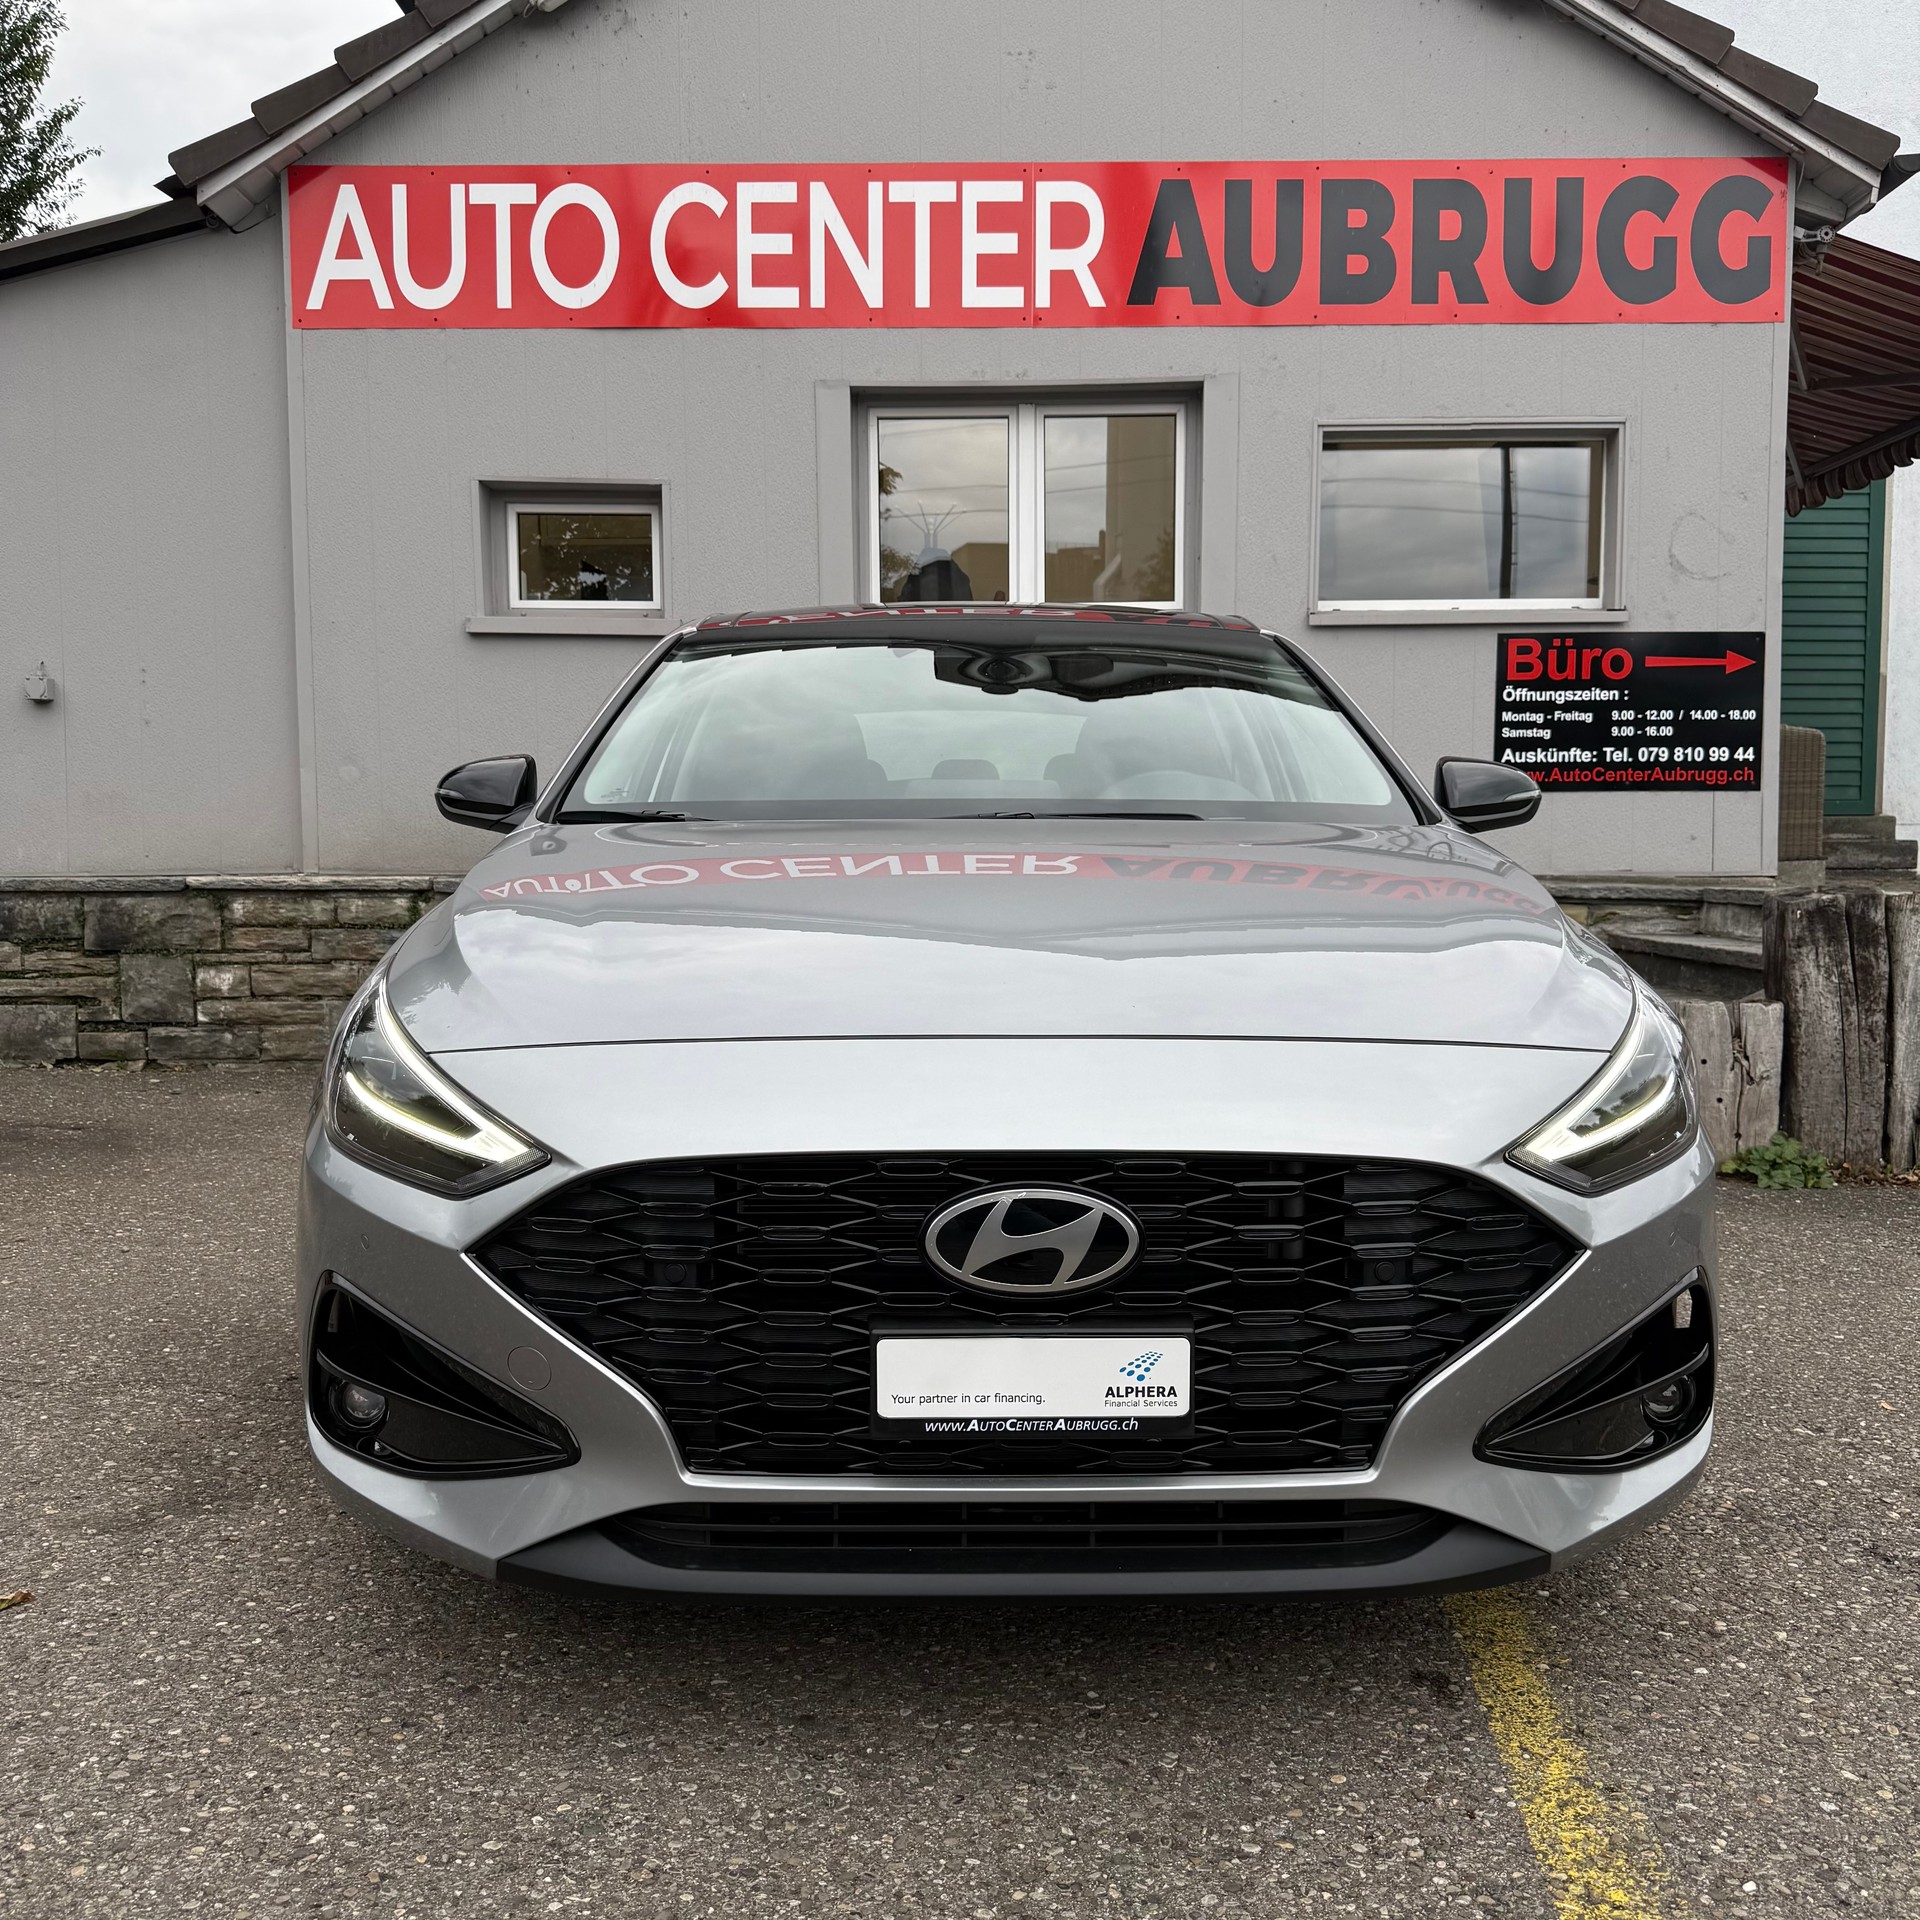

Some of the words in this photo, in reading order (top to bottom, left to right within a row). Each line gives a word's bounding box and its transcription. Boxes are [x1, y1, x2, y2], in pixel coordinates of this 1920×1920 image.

[305, 182, 620, 310] AUTO
[650, 180, 1106, 310] CENTER
[1126, 175, 1775, 307] AUBRUGG
[1506, 638, 1634, 681] Büro
[1502, 685, 1619, 704] Öffnungszeiten
[1501, 711, 1544, 724] Montag
[1554, 710, 1593, 724] Freitag
[1611, 709, 1635, 721] 9.00
[1644, 709, 1674, 721] 12.00
[1689, 709, 1718, 721] 14.00
[1727, 709, 1757, 721] 18.00
[1501, 727, 1551, 740] Samstag
[1611, 725, 1635, 737] 9.00
[1644, 725, 1674, 737] 16.00
[1500, 747, 1598, 763] Auskünfte:
[1602, 746, 1633, 763] Tel.
[1637, 746, 1669, 763] 079
[1673, 746, 1705, 762] 810
[1708, 746, 1730, 762] 99
[1733, 746, 1755, 762] 44
[1526, 766, 1754, 785] w.AutoCenterAubrugg.ch
[891, 1393, 917, 1404] Your
[919, 1393, 958, 1407] partner
[961, 1393, 971, 1403] in
[974, 1395, 991, 1403] car
[994, 1392, 1046, 1406] financing.
[1104, 1385, 1178, 1398] ALPHERA
[1104, 1399, 1141, 1408] Financial
[1143, 1399, 1178, 1408] Services
